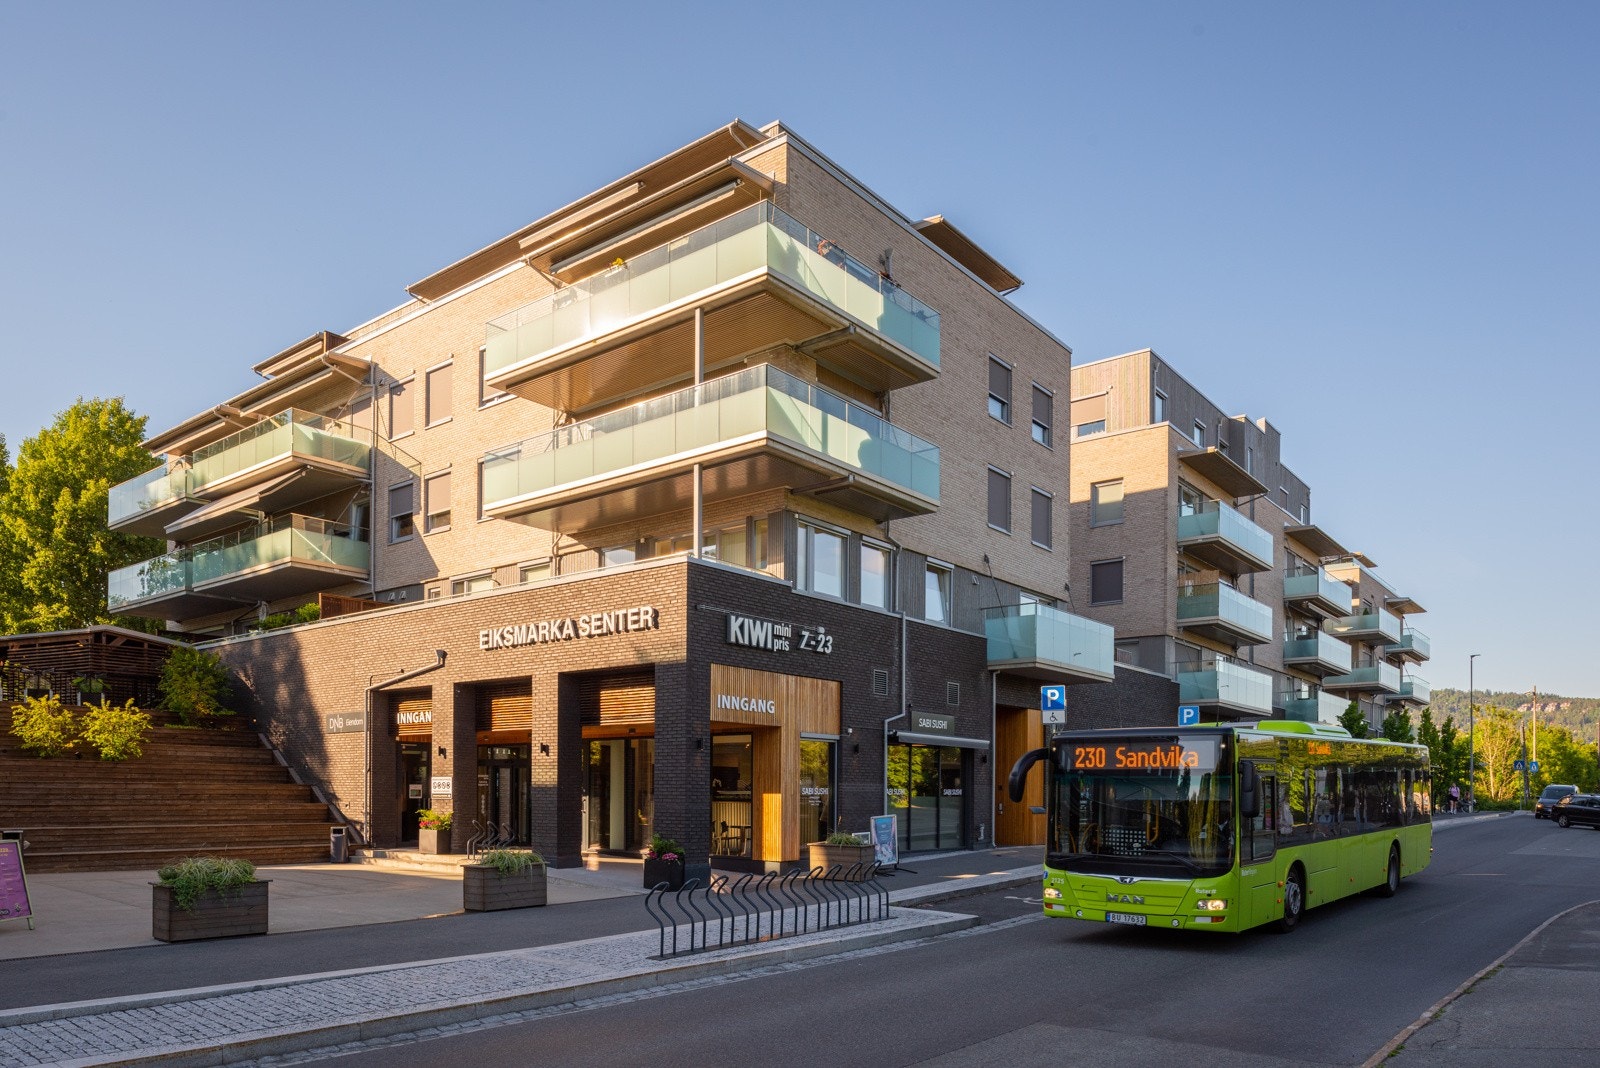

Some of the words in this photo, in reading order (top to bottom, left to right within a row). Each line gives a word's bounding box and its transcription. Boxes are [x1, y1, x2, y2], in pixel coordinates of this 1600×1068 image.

[479, 617, 576, 650] EIKSMARKA
[578, 605, 655, 637] SENTER
[730, 615, 773, 650] KIWI
[773, 623, 792, 638] mini
[773, 637, 790, 652] pris
[717, 694, 775, 714] INNGANG
[1047, 689, 1059, 707] P
[329, 714, 344, 732] DNB
[397, 710, 432, 725] INNGAN
[1183, 708, 1194, 724] P
[918, 718, 932, 728] SABI
[931, 719, 948, 730] SUSHI
[1075, 747, 1106, 768] 230
[1115, 746, 1199, 768] Sandvika
[801, 787, 814, 795] SABI
[814, 787, 829, 795] SUSHI
[1106, 893, 1145, 905] MAN
[1111, 913, 1121, 921] BU
[1123, 914, 1145, 924] 17632
